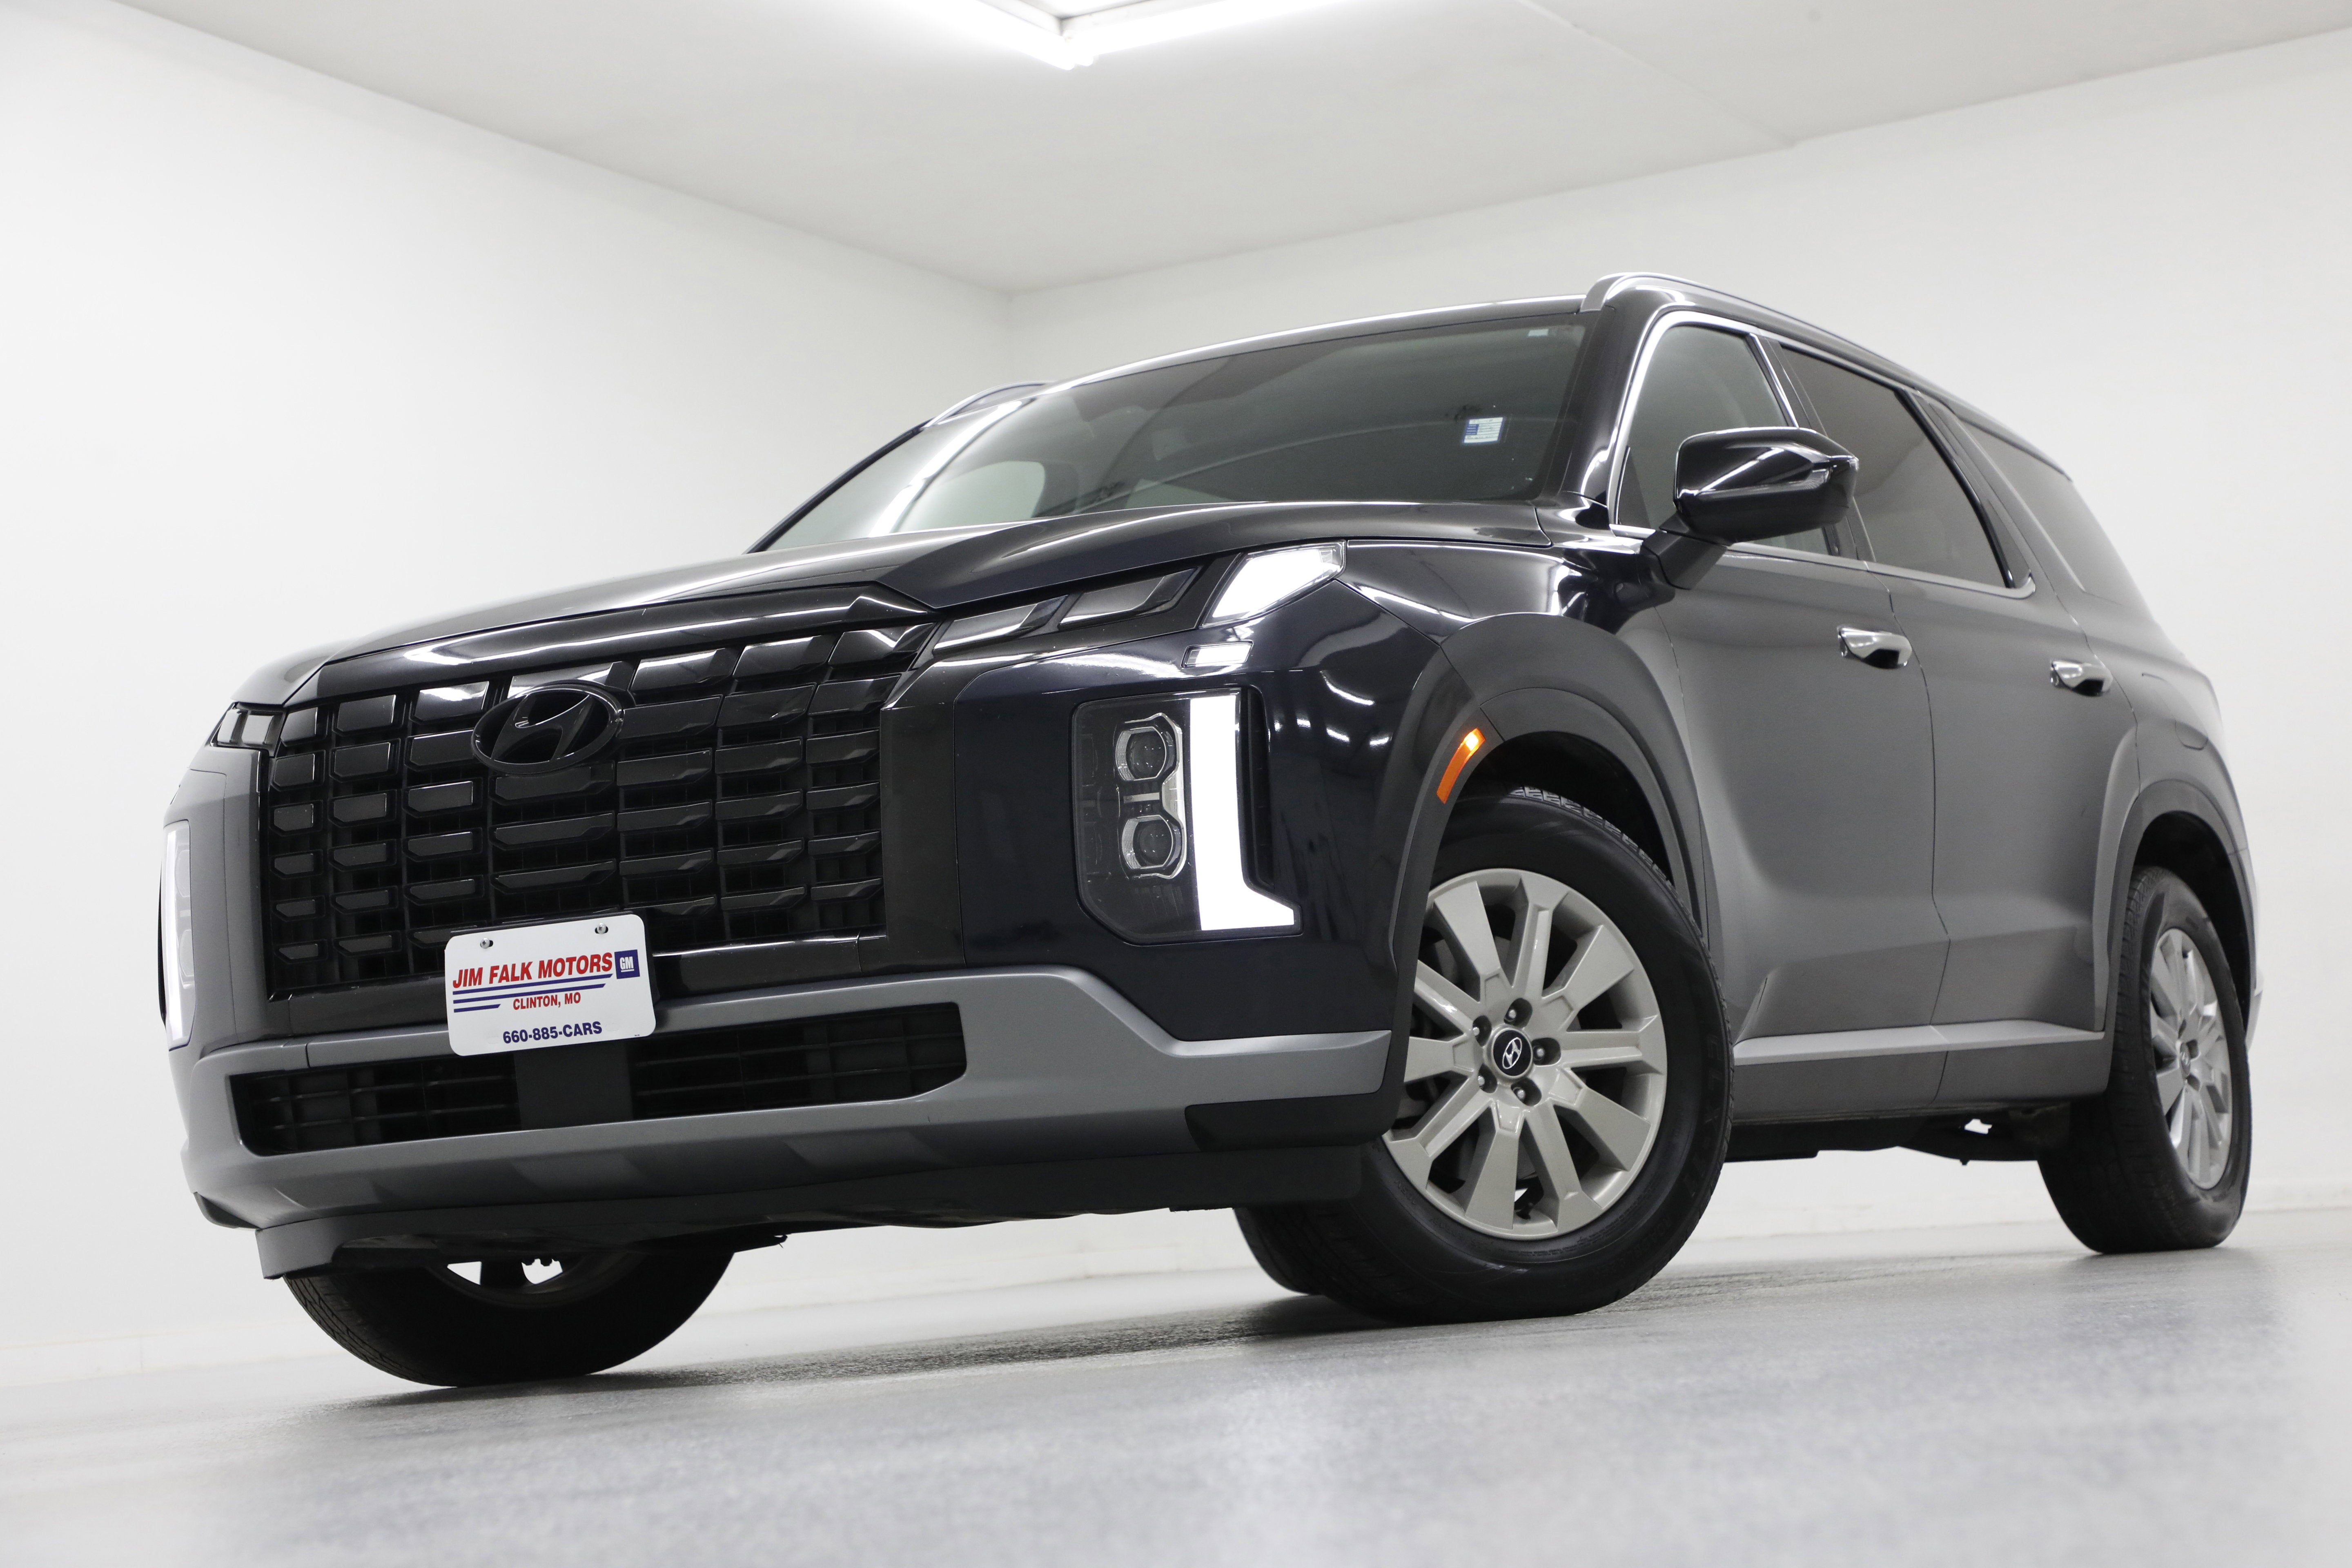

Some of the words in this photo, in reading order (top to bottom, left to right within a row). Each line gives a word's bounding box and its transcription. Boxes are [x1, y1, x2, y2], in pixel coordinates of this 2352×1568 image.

[452, 967, 483, 989] JIM
[489, 961, 533, 984] FALK
[538, 952, 613, 979] MOTORS
[619, 956, 634, 970] GM
[513, 996, 561, 1010] CLINTON,
[564, 992, 581, 1004] MO
[503, 1021, 602, 1044] 660-885-CARS
